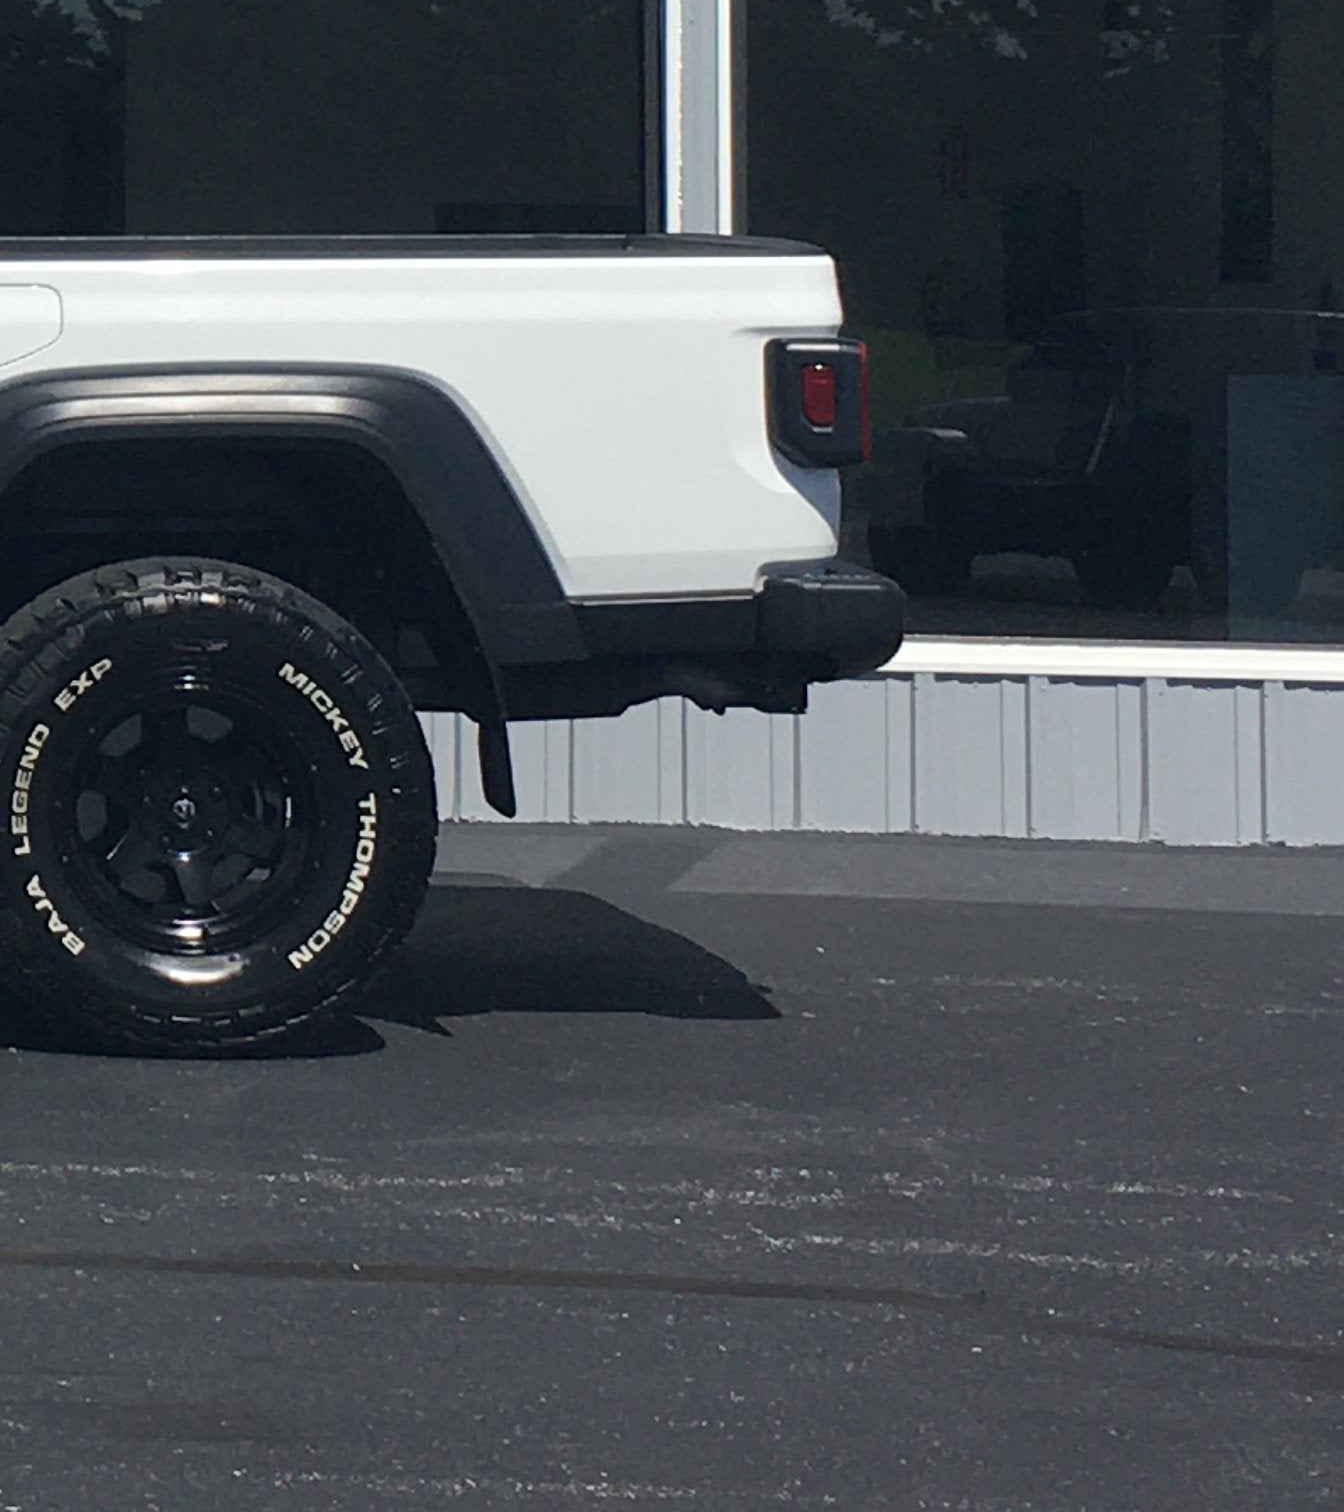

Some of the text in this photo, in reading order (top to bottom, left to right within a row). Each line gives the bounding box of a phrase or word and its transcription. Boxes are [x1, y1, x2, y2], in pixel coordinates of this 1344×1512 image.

[11, 658, 112, 956] BAJA LEGEND EXP
[278, 662, 376, 969] MICKEY THOMPSON
